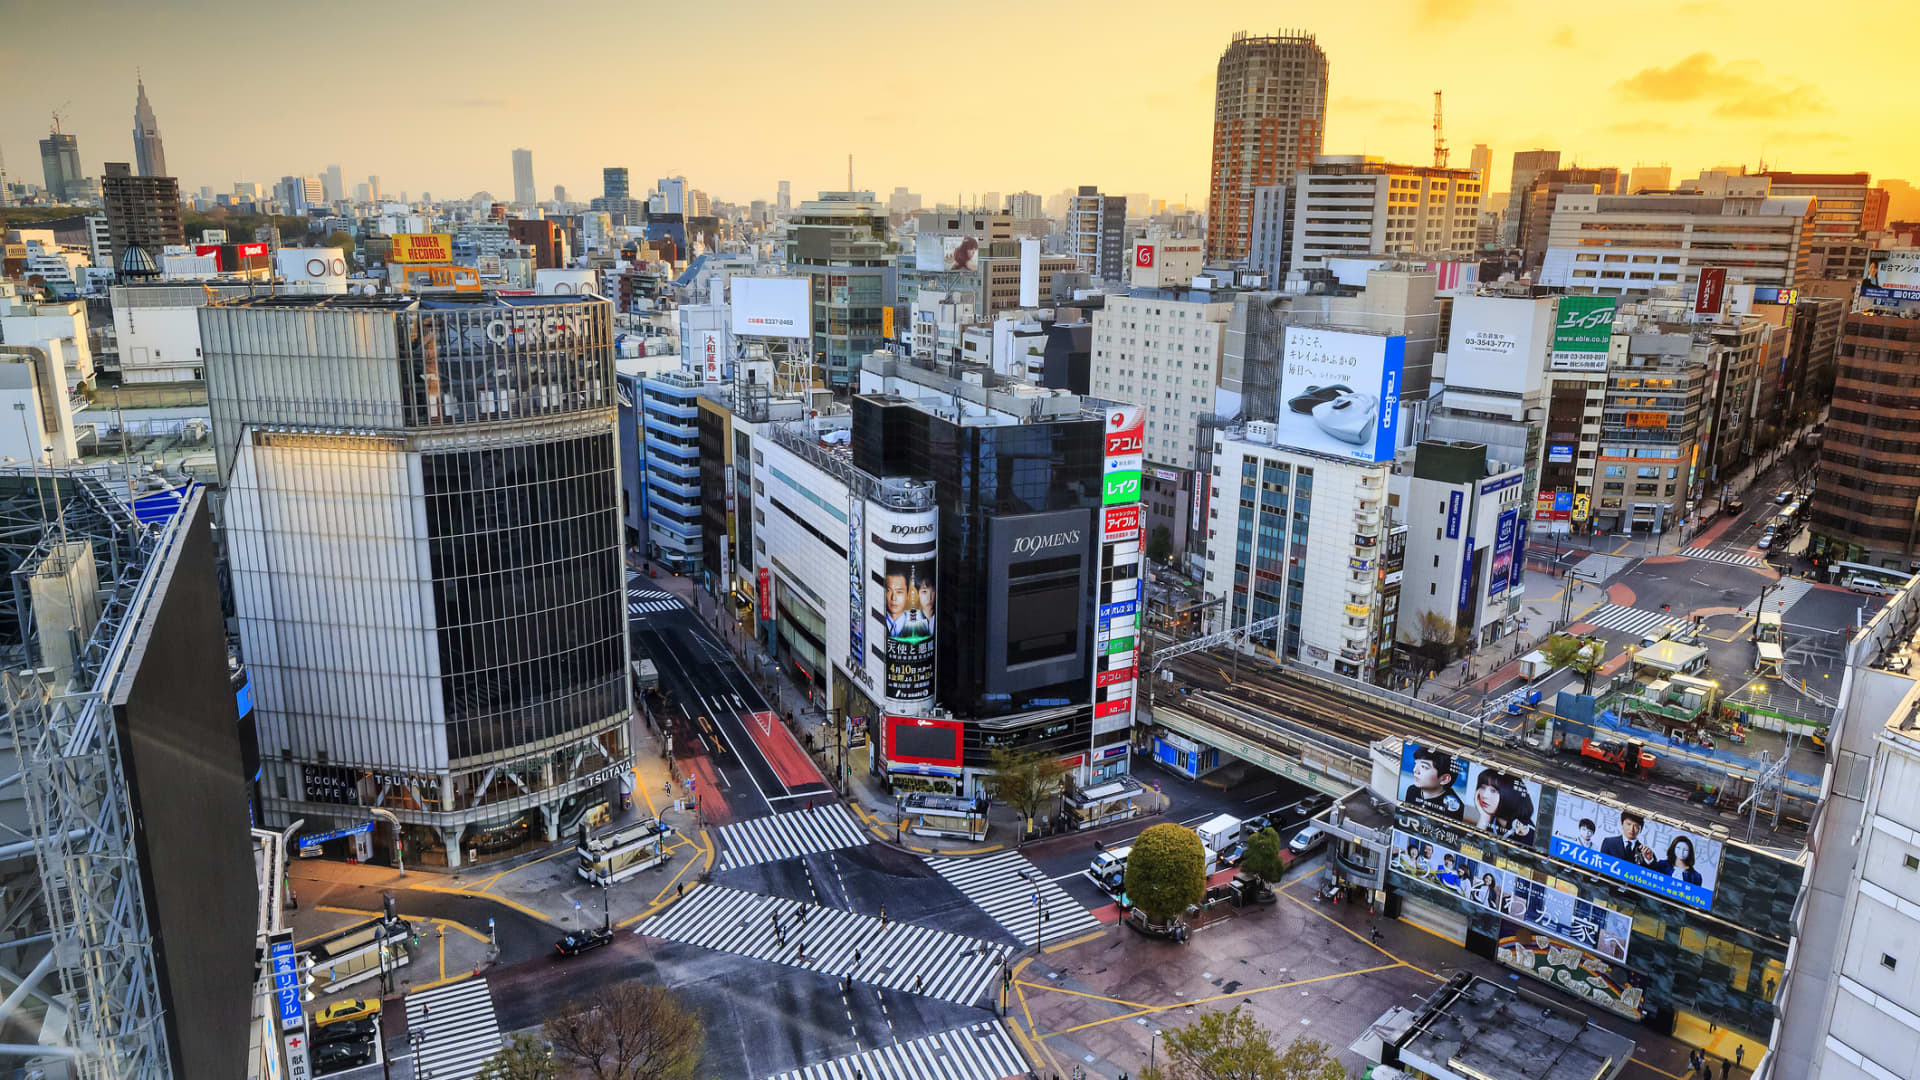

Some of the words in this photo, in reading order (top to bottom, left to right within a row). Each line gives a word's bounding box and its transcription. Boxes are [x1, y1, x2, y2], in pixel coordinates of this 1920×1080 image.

[410, 236, 439, 248] TOWER
[408, 248, 446, 260] RECORDS
[1383, 371, 1397, 428] raycop
[1109, 437, 1142, 452] アコム
[1107, 479, 1138, 496] レイク
[1107, 516, 1137, 530] アイフル
[1100, 673, 1121, 685] アコム
[588, 761, 632, 786] TSUTAYA
[375, 774, 438, 789] TSUTAYA
[307, 786, 340, 798] CAFE
[1399, 816, 1420, 832] JR
[1559, 841, 1622, 876] アイムホーム
[286, 1019, 299, 1027] 9F
[291, 1054, 305, 1080] 献血
